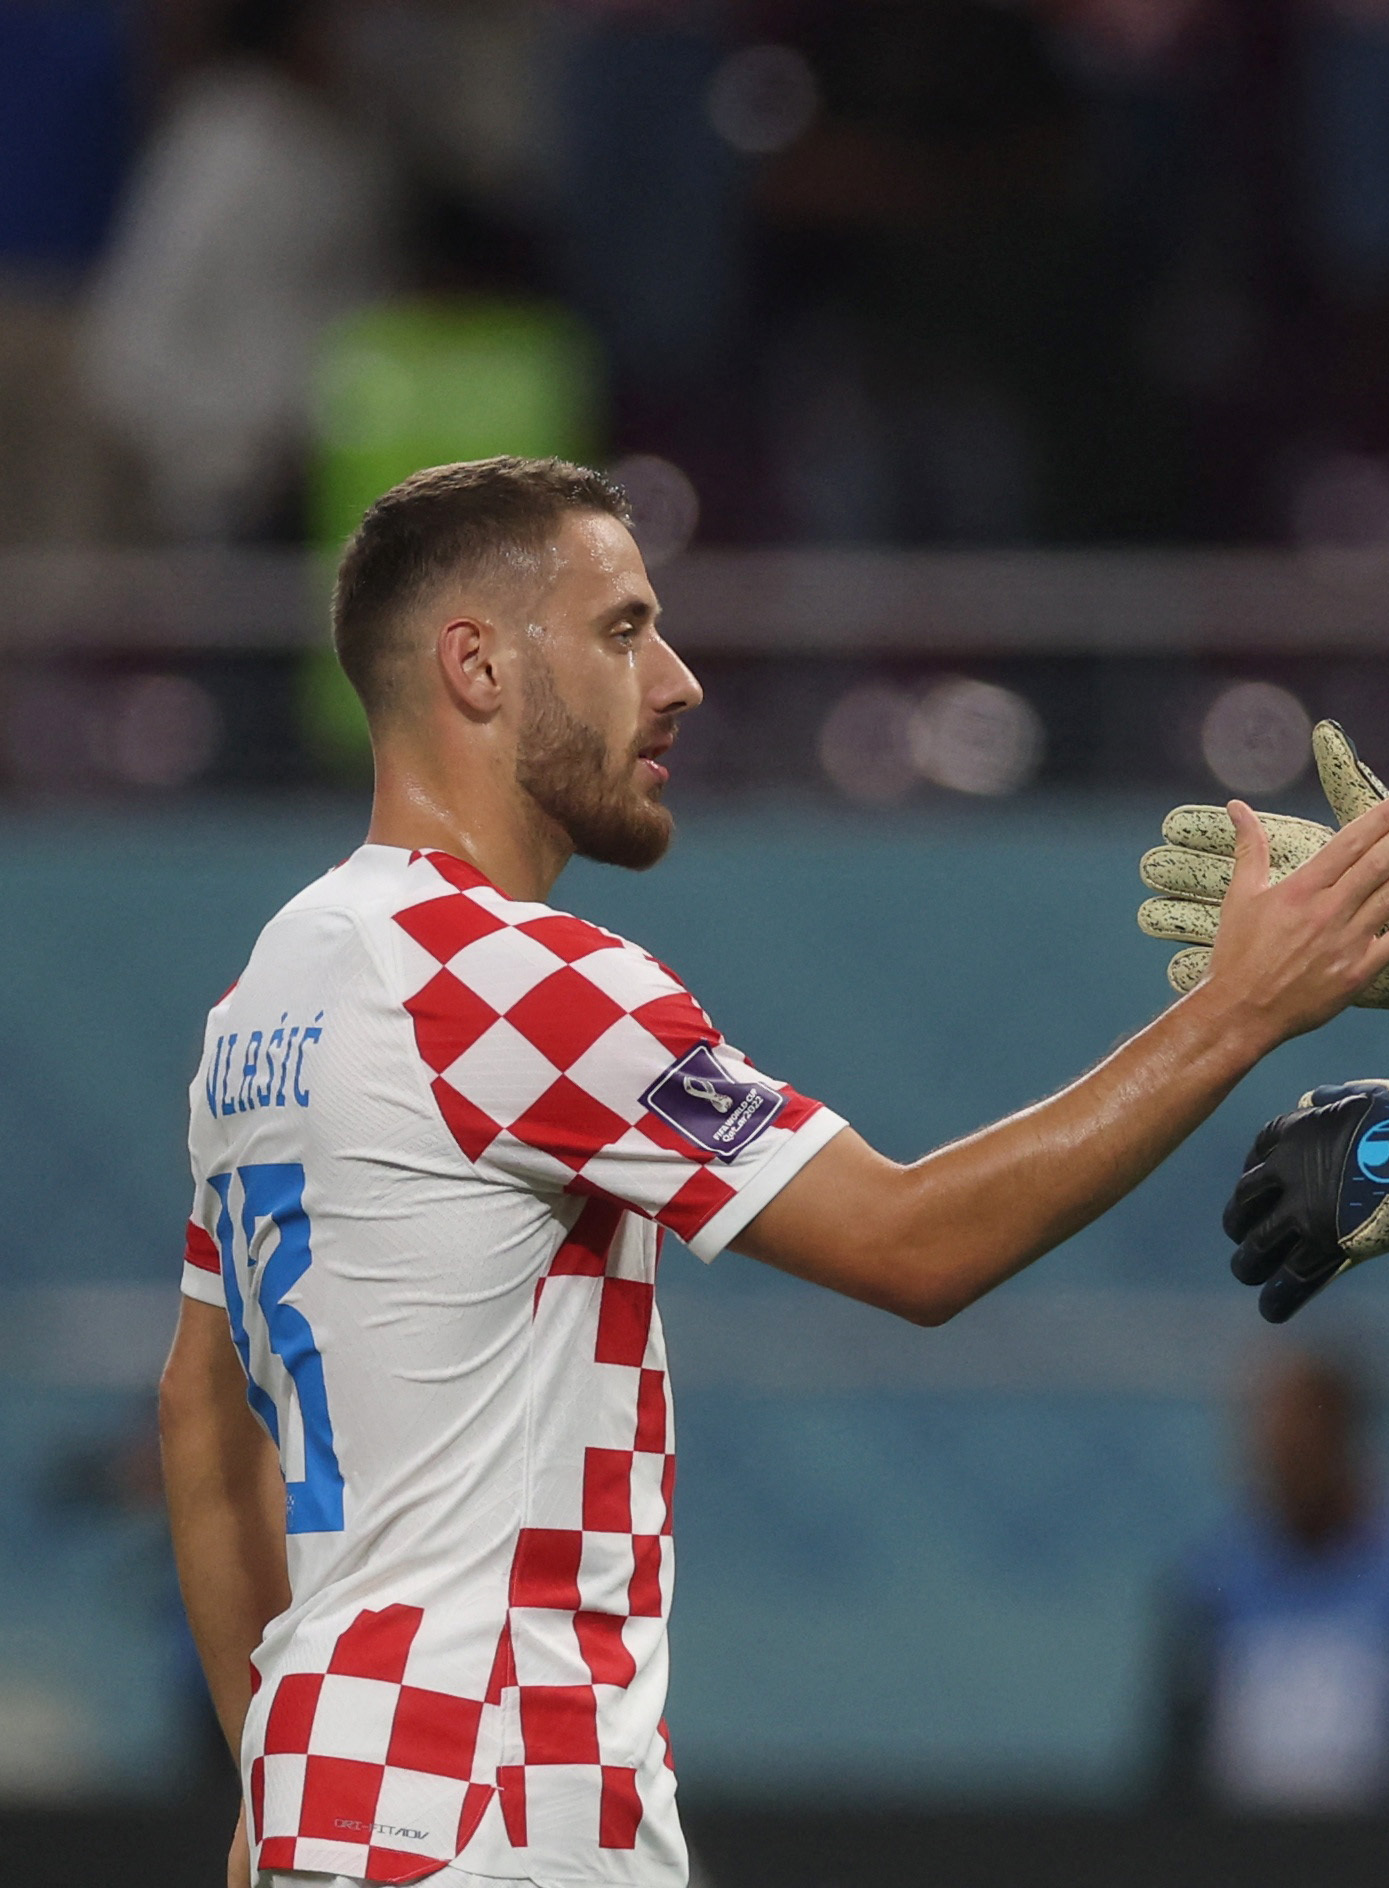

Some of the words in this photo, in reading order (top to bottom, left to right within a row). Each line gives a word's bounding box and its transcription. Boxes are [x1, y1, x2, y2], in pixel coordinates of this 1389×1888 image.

[712, 1125, 729, 1141] FIFA
[725, 1101, 749, 1127] WORLD
[746, 1088, 757, 1103] CUP
[743, 1095, 764, 1119] 2022
